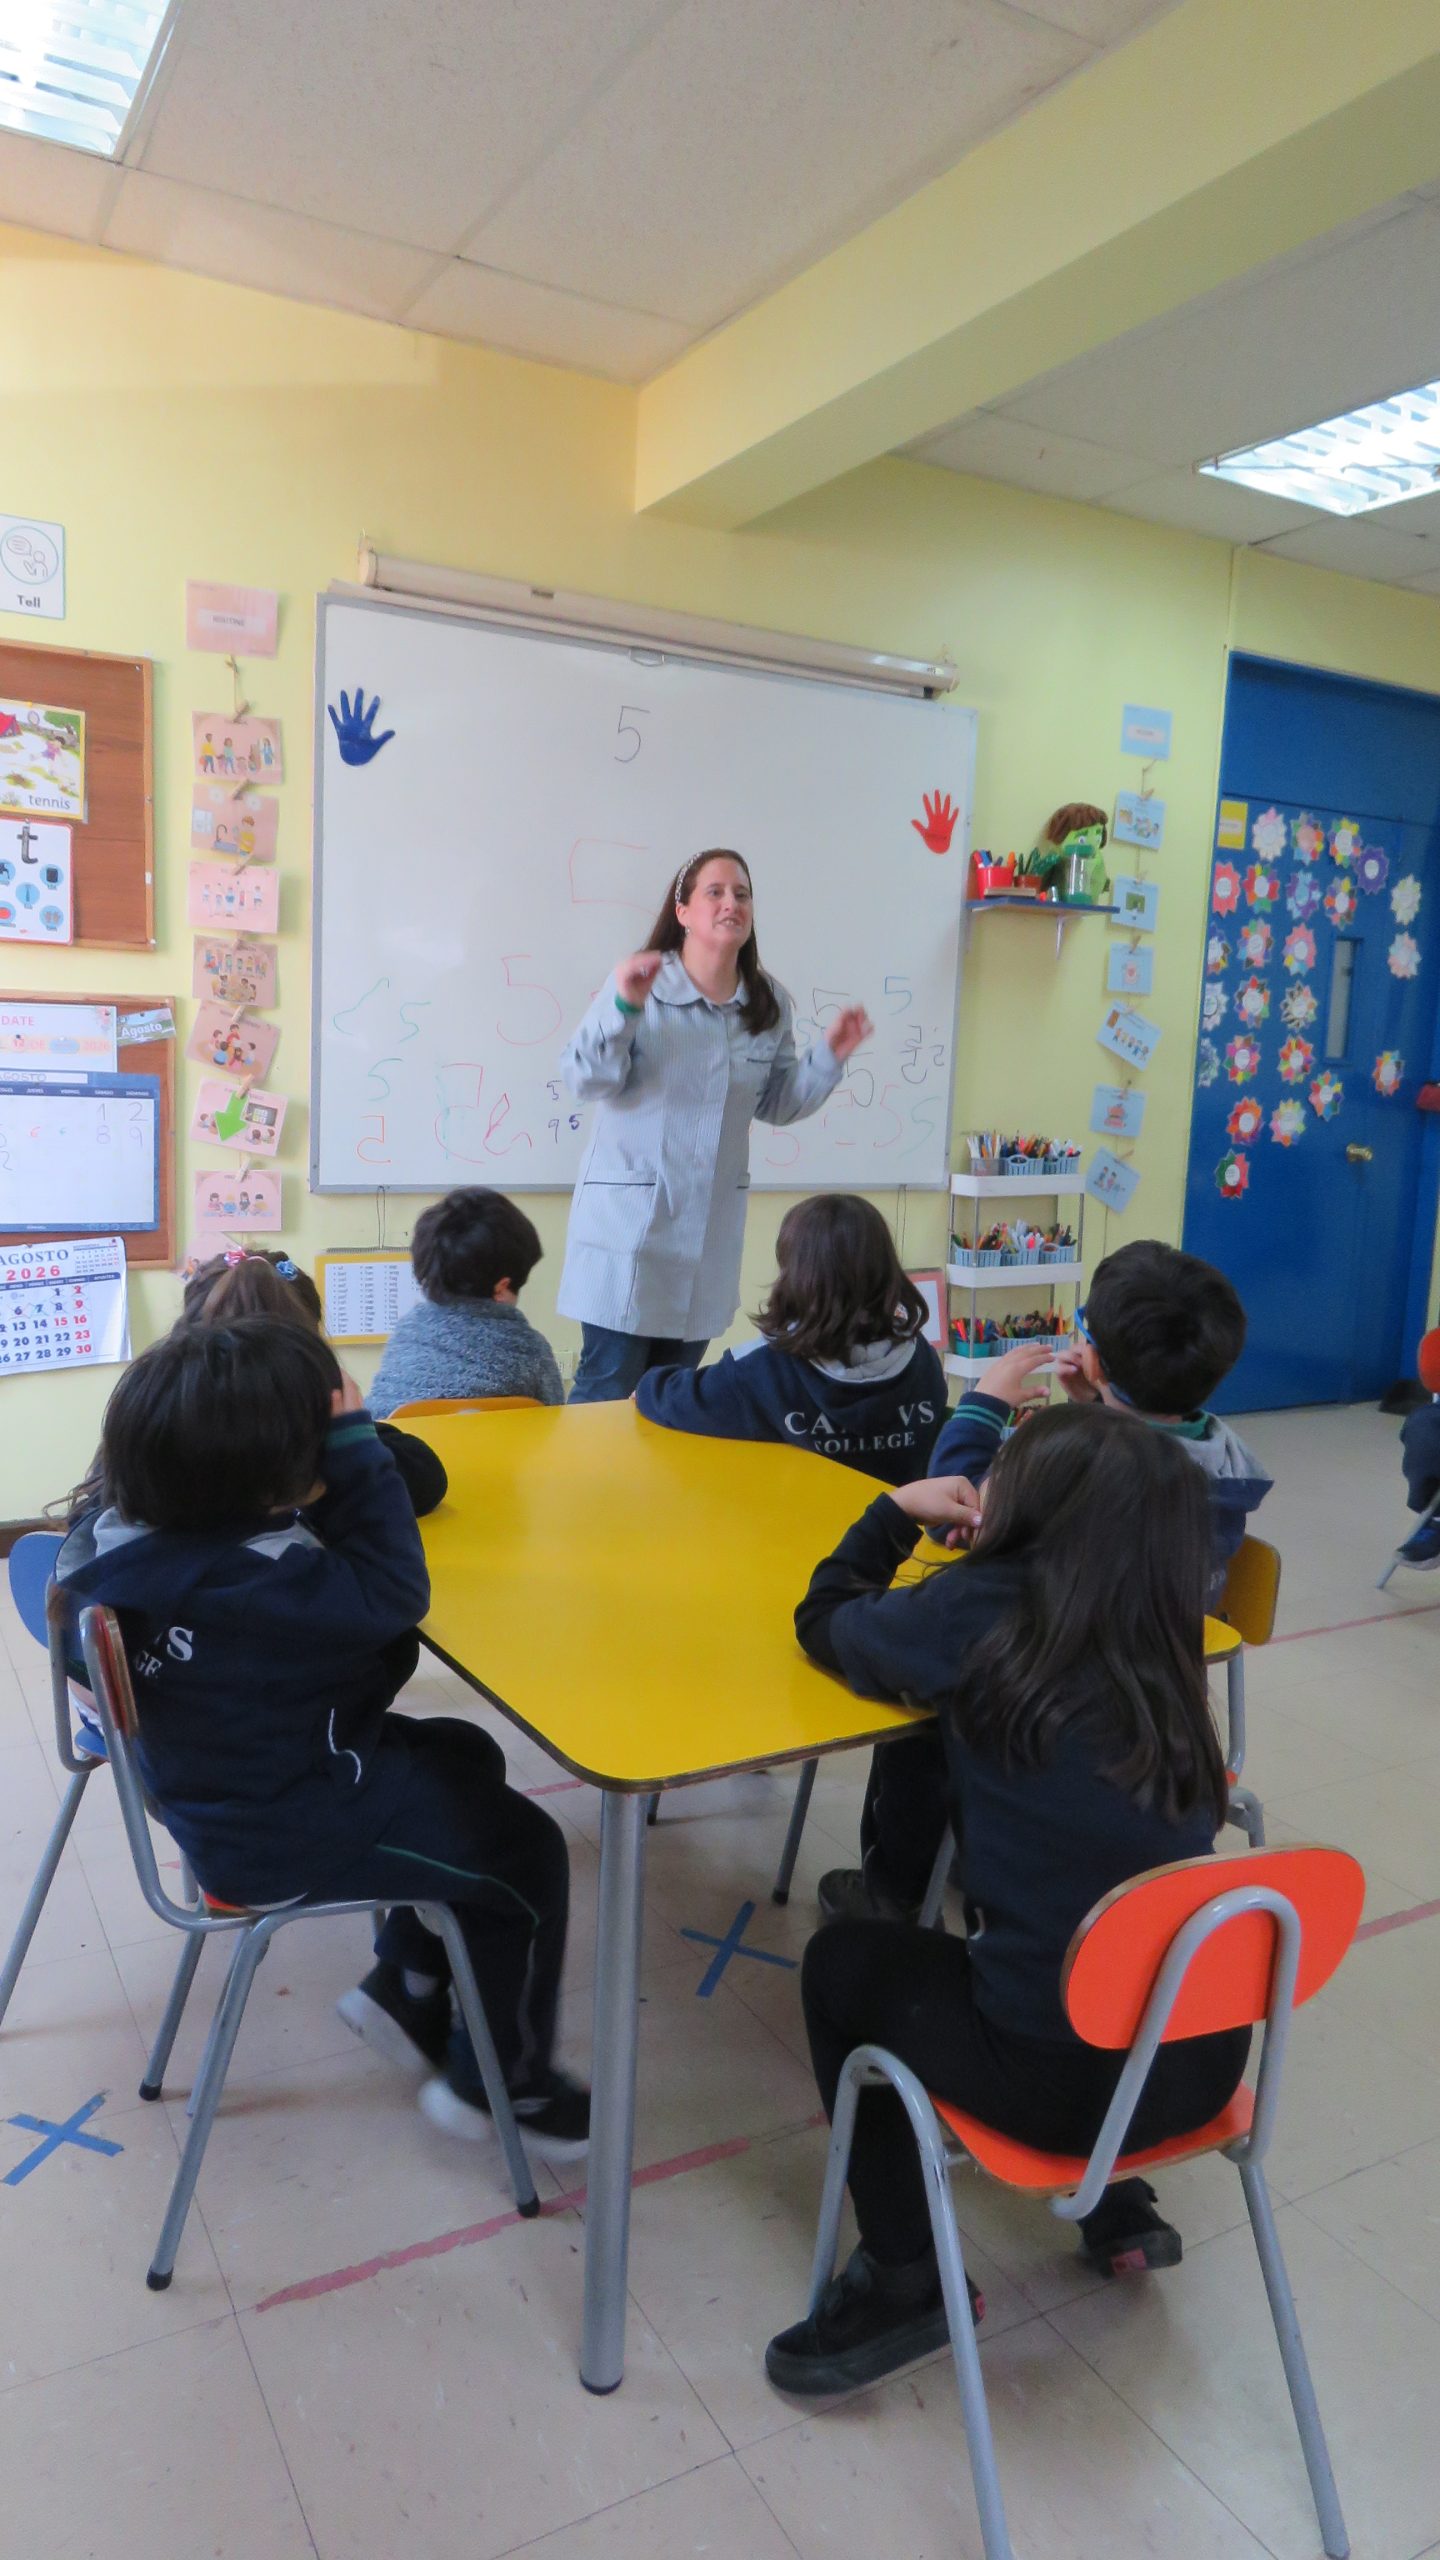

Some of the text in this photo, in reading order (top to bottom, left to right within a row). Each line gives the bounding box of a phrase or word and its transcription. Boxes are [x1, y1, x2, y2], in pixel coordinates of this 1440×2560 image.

[17, 594, 41, 608] Tell
[614, 705, 650, 763] 5
[28, 793, 71, 810] tennis
[16, 825, 39, 864] t
[496, 955, 563, 1046] 5
[884, 976, 912, 1015] 5
[1, 1016, 35, 1026] DATE
[121, 1023, 163, 1039] Agosto
[367, 1057, 404, 1101] 5
[846, 1051, 875, 1108] 5
[97, 1101, 149, 1122] 1 2
[568, 1113, 584, 1131] 5
[96, 1125, 112, 1145] 8
[128, 1126, 144, 1149] 9
[6, 1265, 61, 1281] 2026
[54, 1285, 82, 1297] 1 2
[14, 1300, 84, 1316] 6 7 8 9
[12, 1321, 27, 1332] 13
[33, 1319, 48, 1329] 14
[54, 1317, 68, 1327] 15
[73, 1314, 88, 1325] 16
[13, 1337, 30, 1347] 20
[35, 1334, 49, 1344] 21
[54, 1332, 70, 1342] 22
[75, 1329, 91, 1340] 23
[14, 1351, 31, 1362] 27
[35, 1349, 52, 1360] 28
[56, 1347, 72, 1357] 29
[75, 1344, 92, 1354] 30
